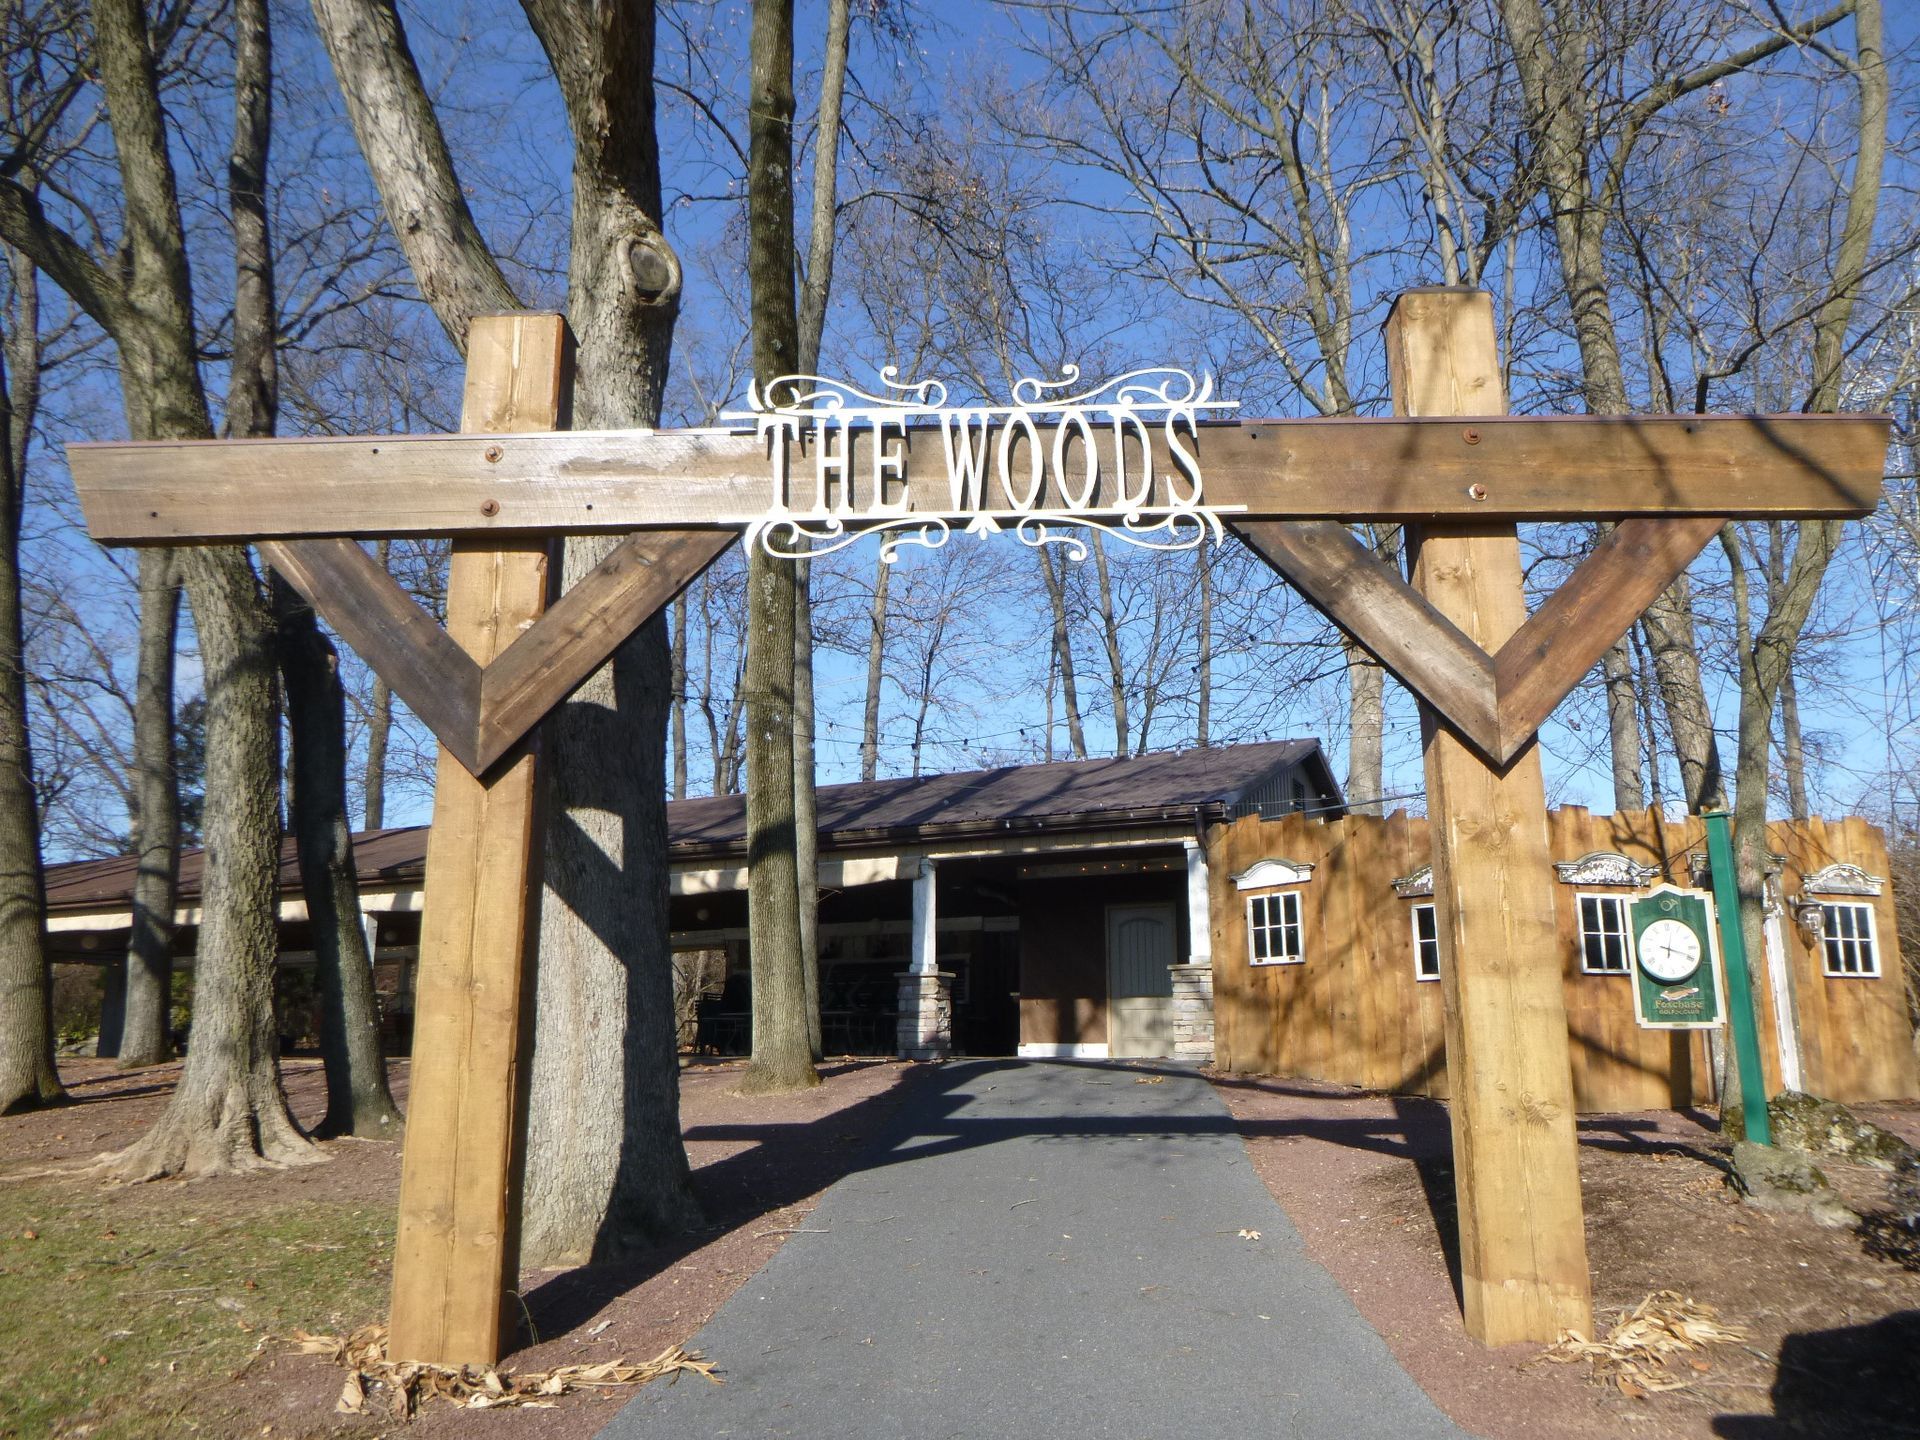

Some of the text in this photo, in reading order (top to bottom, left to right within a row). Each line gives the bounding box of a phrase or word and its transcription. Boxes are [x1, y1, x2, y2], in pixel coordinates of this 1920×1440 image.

[757, 408, 1204, 515] THE WOODS
[1655, 999, 1704, 1009] Foxchase
